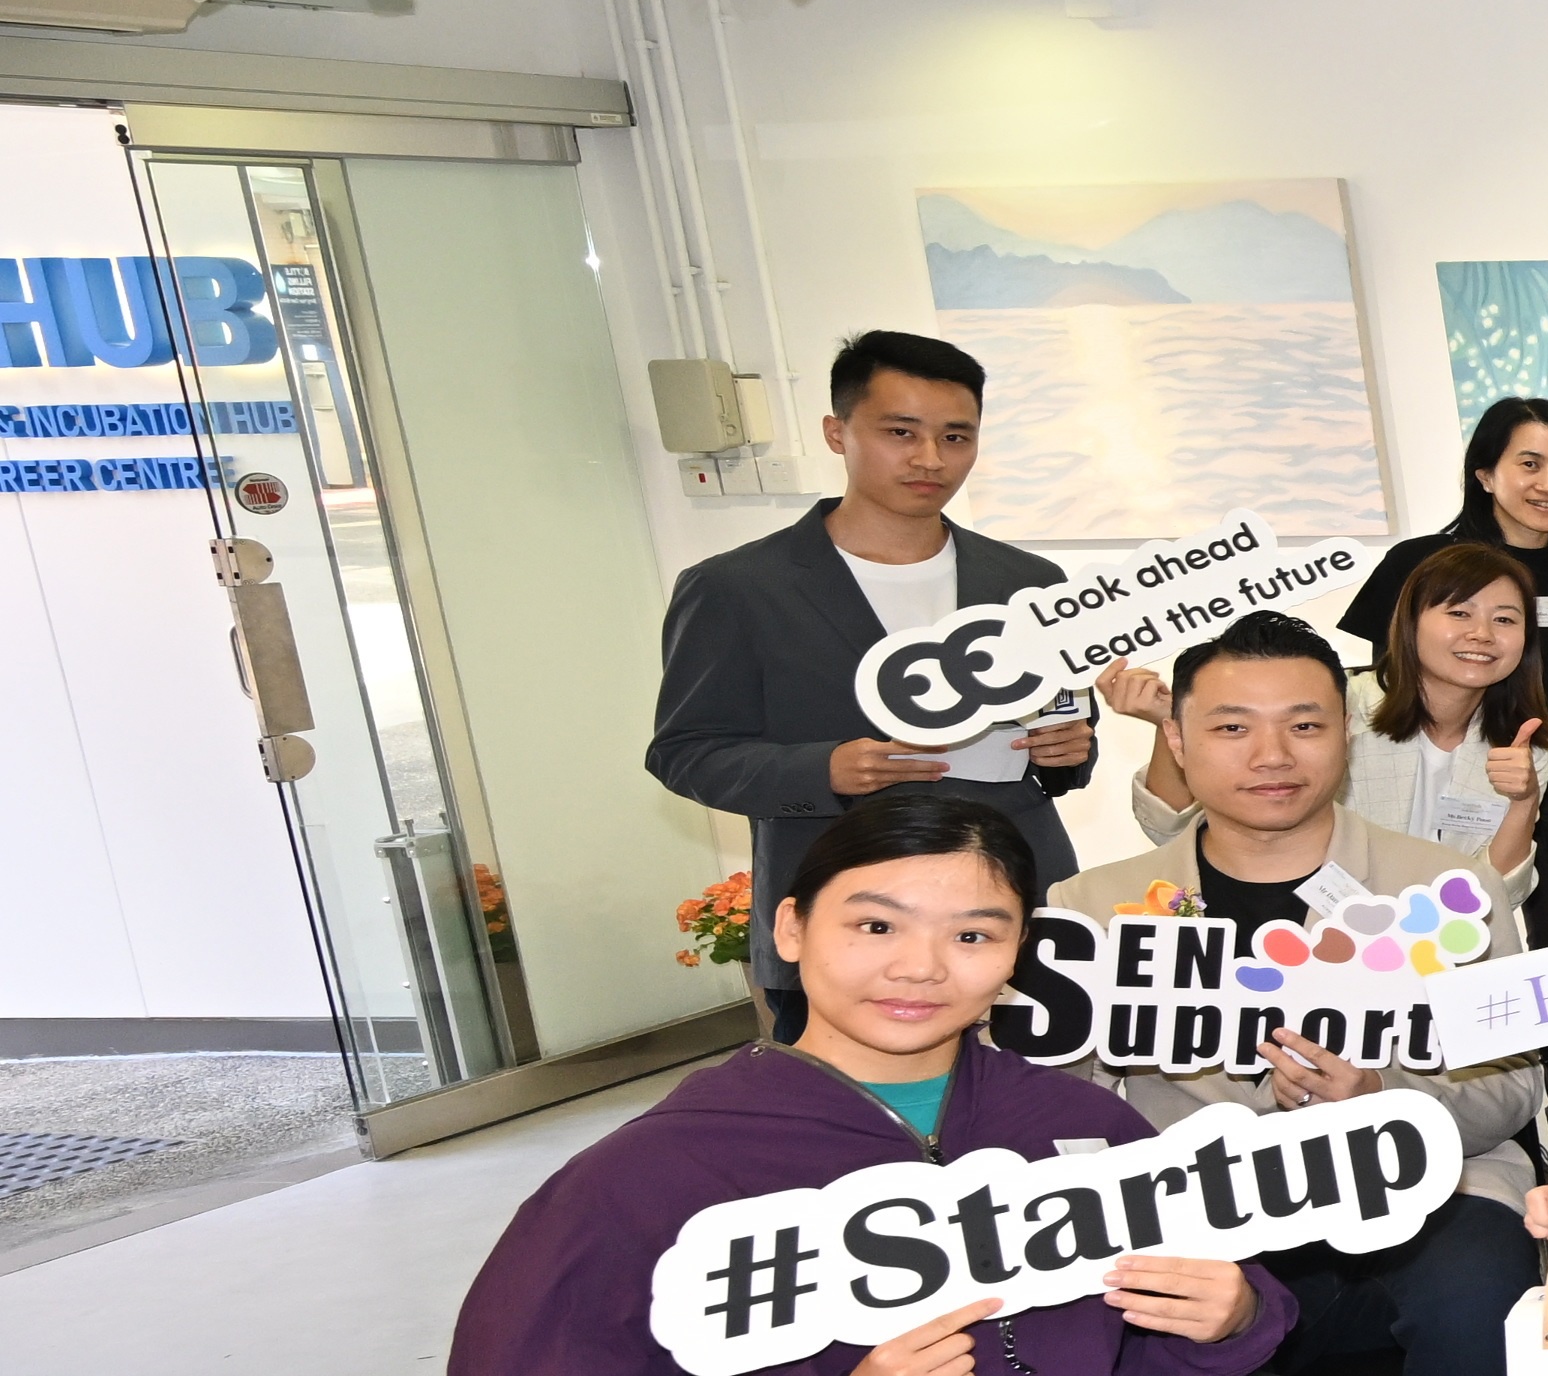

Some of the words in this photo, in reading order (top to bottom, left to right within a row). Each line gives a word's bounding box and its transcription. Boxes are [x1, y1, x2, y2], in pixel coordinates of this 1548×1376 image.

[25, 402, 224, 438] INCUBATION
[228, 400, 298, 434] HUB
[95, 455, 236, 491] CENTRE
[1029, 572, 1131, 630] Look
[1136, 522, 1260, 588] ahead
[1060, 617, 1163, 675] Lead
[1168, 592, 1234, 636] the
[1238, 548, 1357, 615] future
[704, 1116, 1429, 1340] #Startup
